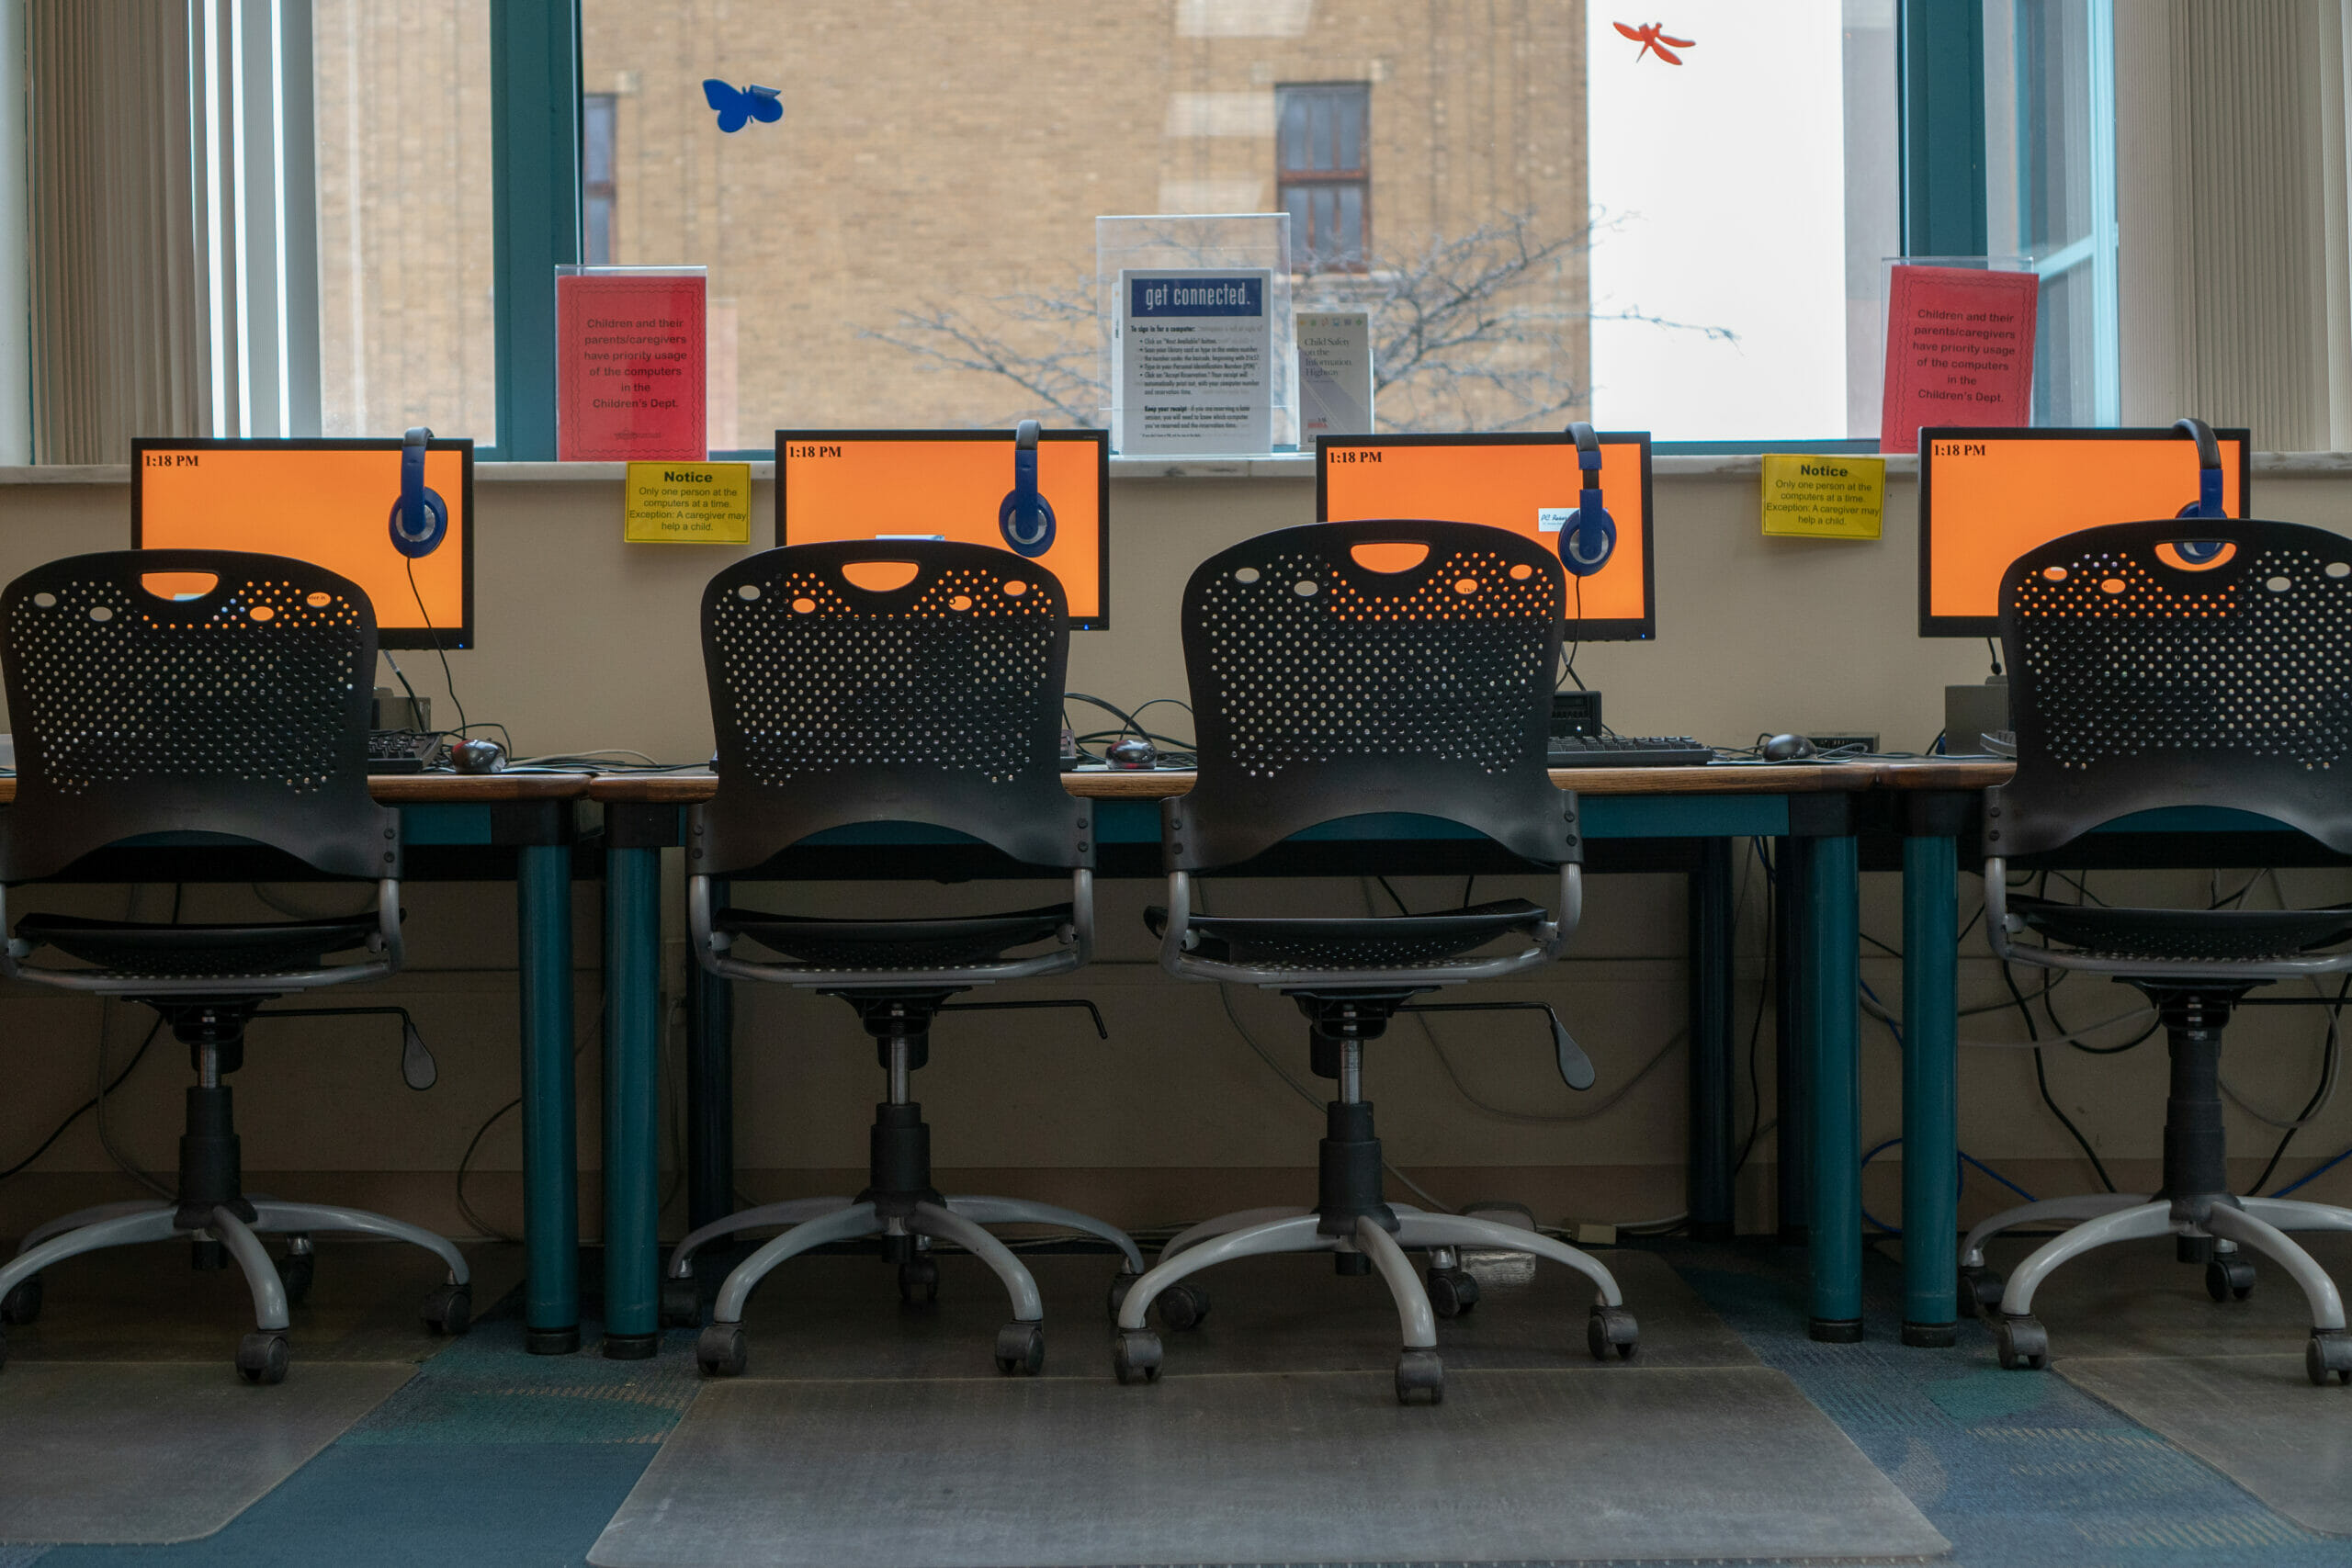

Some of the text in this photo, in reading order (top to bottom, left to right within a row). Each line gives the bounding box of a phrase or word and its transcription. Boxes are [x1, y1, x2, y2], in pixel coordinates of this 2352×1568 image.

[1146, 282, 1250, 310] get connected.
[1917, 309, 2014, 323] Children and their
[587, 319, 684, 329] Children and their
[1914, 326, 2015, 340] parents/caregivers
[584, 335, 686, 346] parents/caregivers
[1304, 337, 1350, 348] Child Safety
[1316, 348, 1329, 356] the
[1913, 342, 2015, 356] have priority usage
[583, 351, 687, 362] have priority usage
[1306, 358, 1352, 367] Information
[1917, 358, 2009, 371] of the computers
[589, 367, 682, 378] of the computers
[1948, 376, 1976, 386] in the
[621, 383, 650, 392] in the
[1917, 389, 2004, 404] Children's Dept.
[593, 399, 679, 410] Children's Dept.
[789, 446, 842, 458] 1:18 PM
[1934, 445, 1985, 457] 1:18 PM
[145, 455, 198, 467] 1:18 PM
[1329, 451, 1382, 463] 1:18 PM
[1801, 464, 1849, 477] Notice
[664, 471, 713, 483] Notice
[1775, 479, 1796, 490] Only
[1798, 481, 1814, 490] one
[1815, 482, 1845, 491] person
[1858, 483, 1871, 491] the
[639, 487, 737, 498] Only one person at the
[1781, 492, 1825, 502] computers
[1826, 493, 1836, 502] at
[1845, 494, 1864, 502] time.
[643, 500, 689, 509] computers
[692, 499, 701, 507] at
[711, 499, 732, 508] time.
[1766, 502, 1810, 513] Exception:
[1820, 505, 1860, 515] caregiver
[1861, 508, 1880, 516] may
[629, 510, 747, 522] Exception: A caregiver may
[1798, 514, 1815, 525] help
[1825, 516, 1846, 525] child.
[662, 522, 680, 531] help
[691, 522, 714, 531] child.
